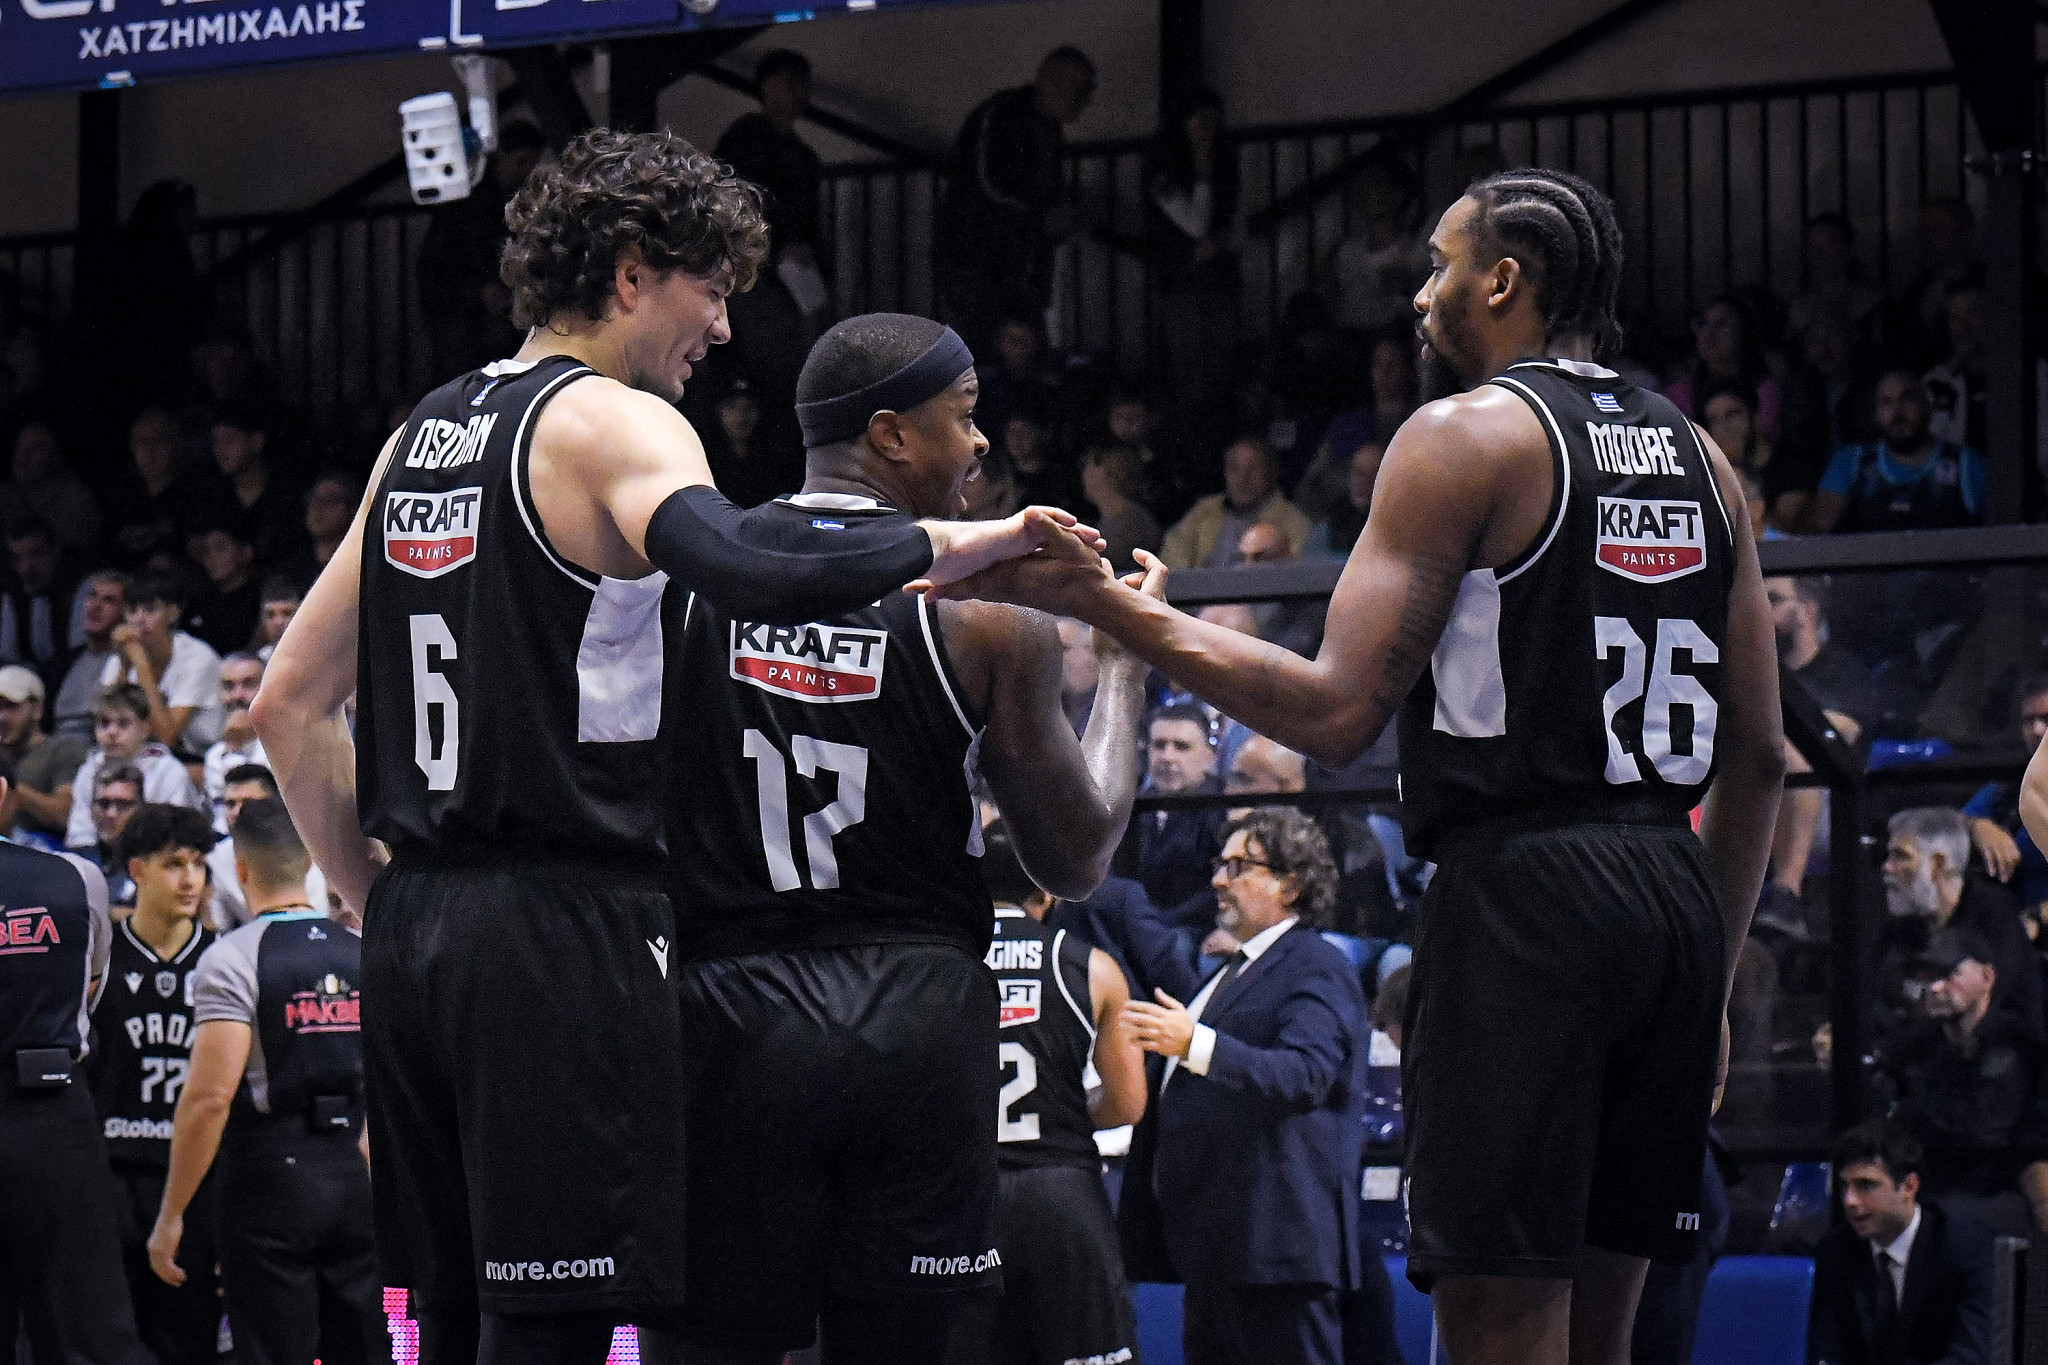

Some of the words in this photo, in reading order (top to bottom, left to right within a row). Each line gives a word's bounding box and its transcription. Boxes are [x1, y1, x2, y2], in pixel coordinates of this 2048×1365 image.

[405, 412, 499, 470] OSMAN
[1585, 420, 1686, 476] MOORE
[386, 493, 478, 533] KRAFT
[1599, 502, 1699, 540] KRAFT
[408, 545, 452, 560] PAINTS
[1623, 552, 1676, 566] PAINTS
[734, 620, 882, 669] KRAFT
[409, 613, 459, 791] 6
[1594, 615, 1719, 786] 26
[743, 729, 869, 893] 17
[983, 940, 1044, 970] GINS
[485, 1256, 615, 1281] more.com
[910, 1248, 1002, 1275] more.cm
